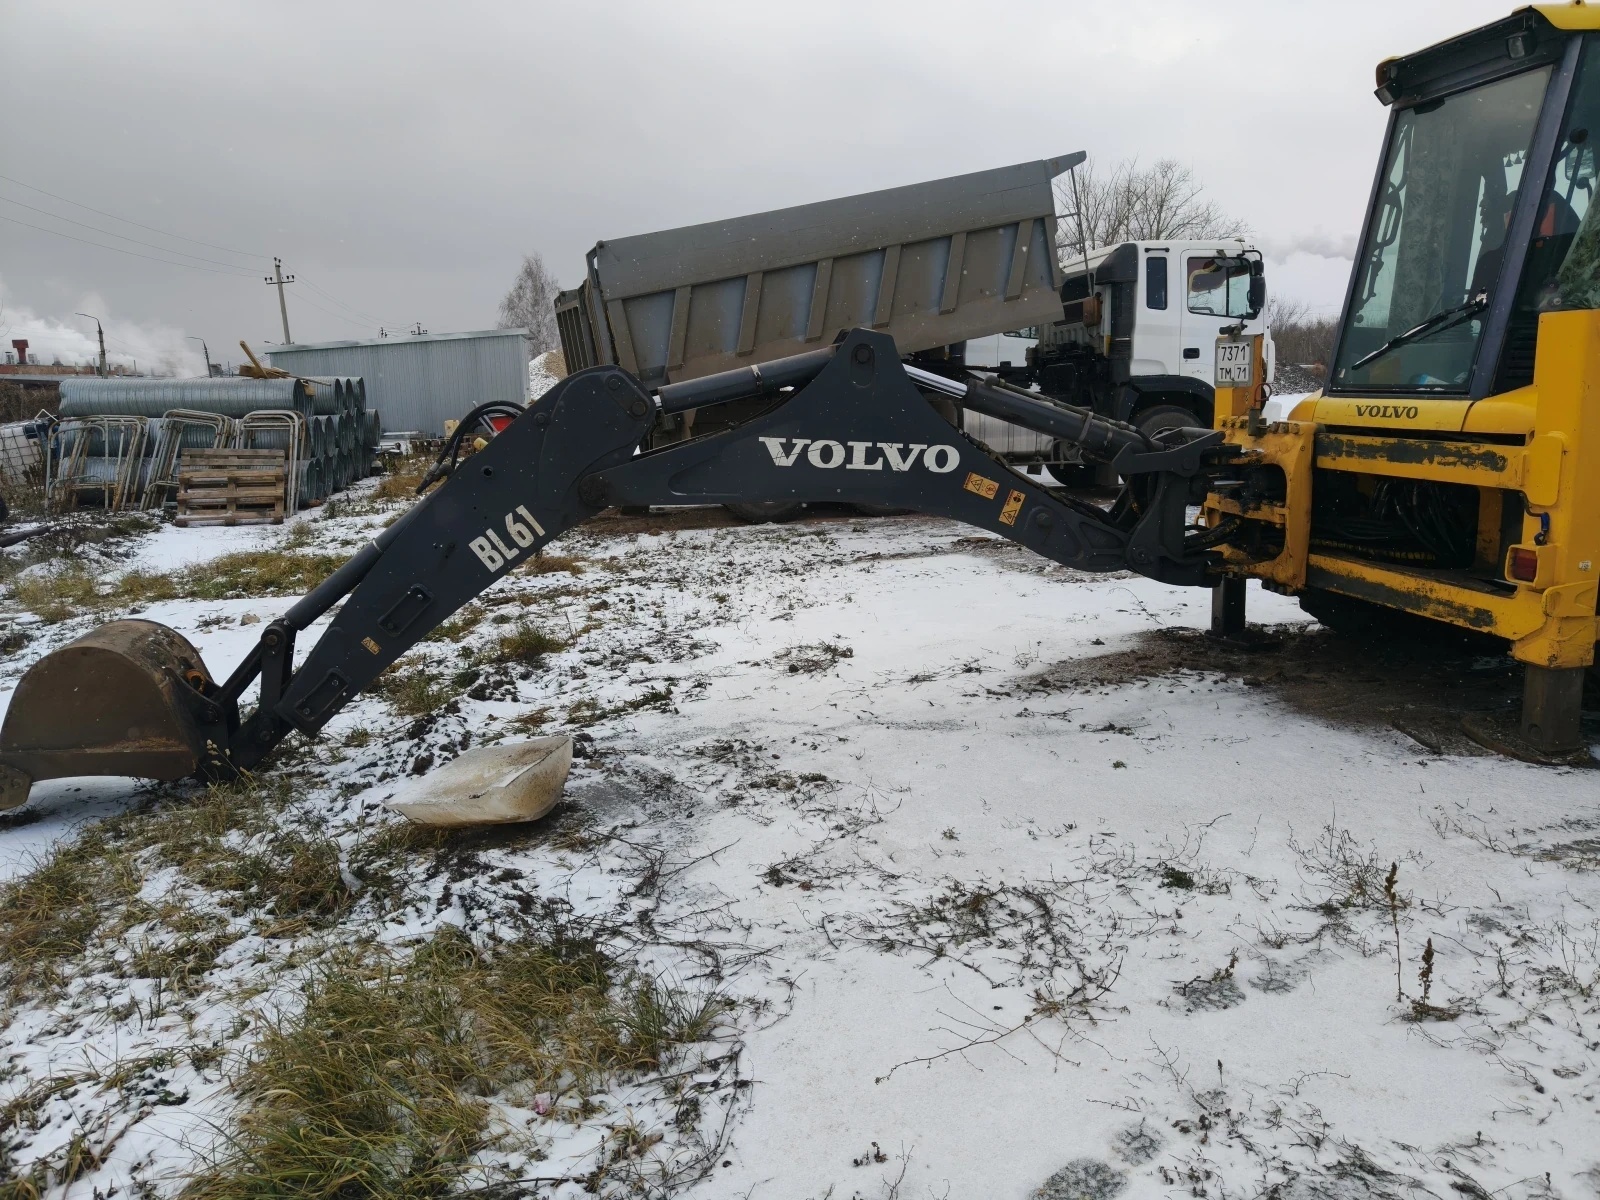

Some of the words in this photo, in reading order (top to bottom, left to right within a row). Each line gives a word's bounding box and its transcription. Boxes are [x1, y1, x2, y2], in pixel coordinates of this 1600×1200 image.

[1221, 345, 1246, 361] 7371
[1236, 367, 1247, 380] 71
[1355, 404, 1419, 420] VOLVO
[758, 436, 961, 474] VOLVO
